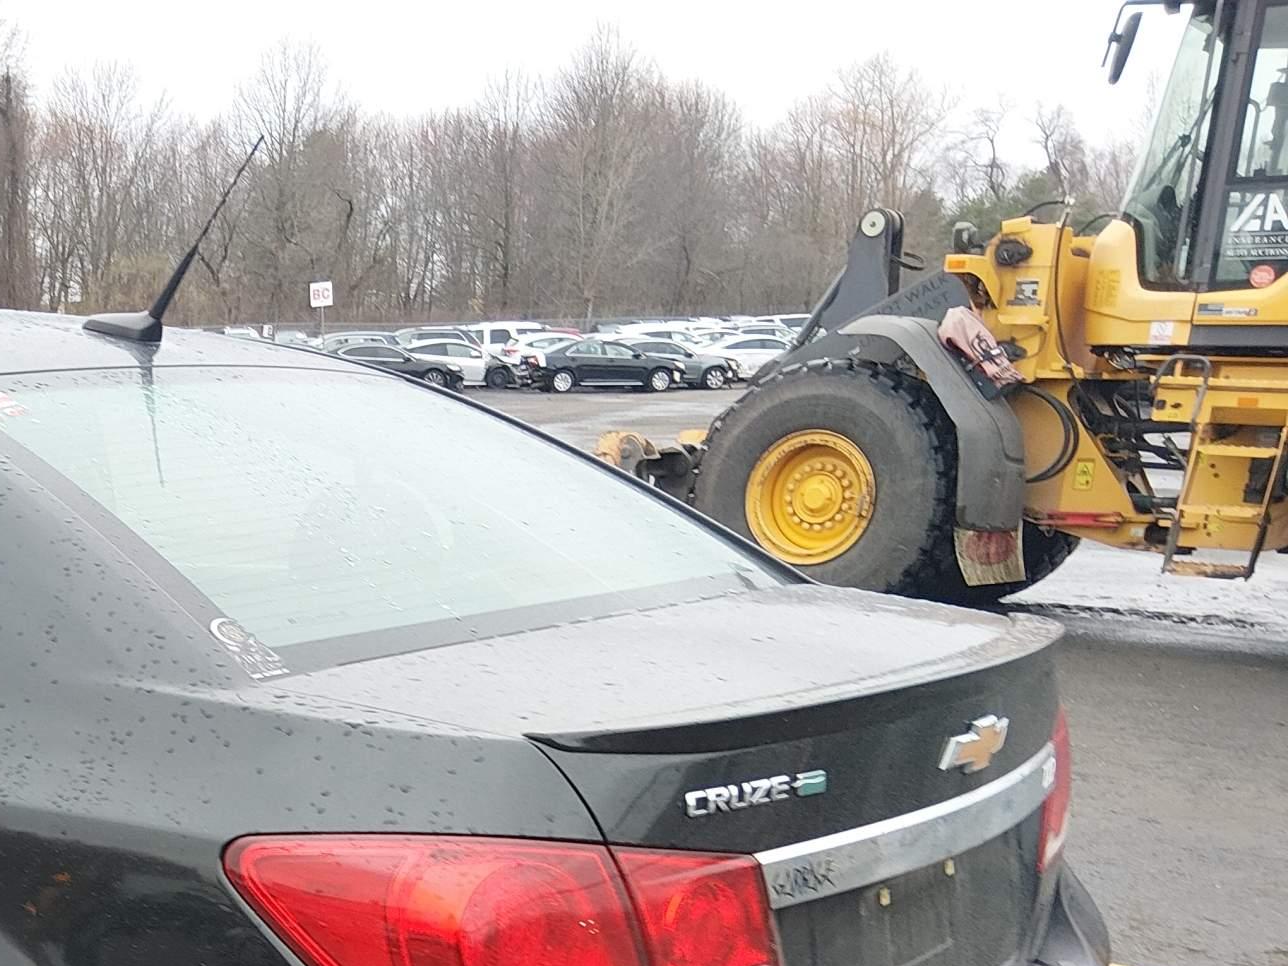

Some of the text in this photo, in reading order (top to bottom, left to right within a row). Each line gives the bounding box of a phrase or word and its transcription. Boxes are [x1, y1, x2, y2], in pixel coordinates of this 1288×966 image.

[312, 288, 331, 301] BC
[905, 276, 949, 303] WALK
[684, 774, 791, 818] CRUZE
